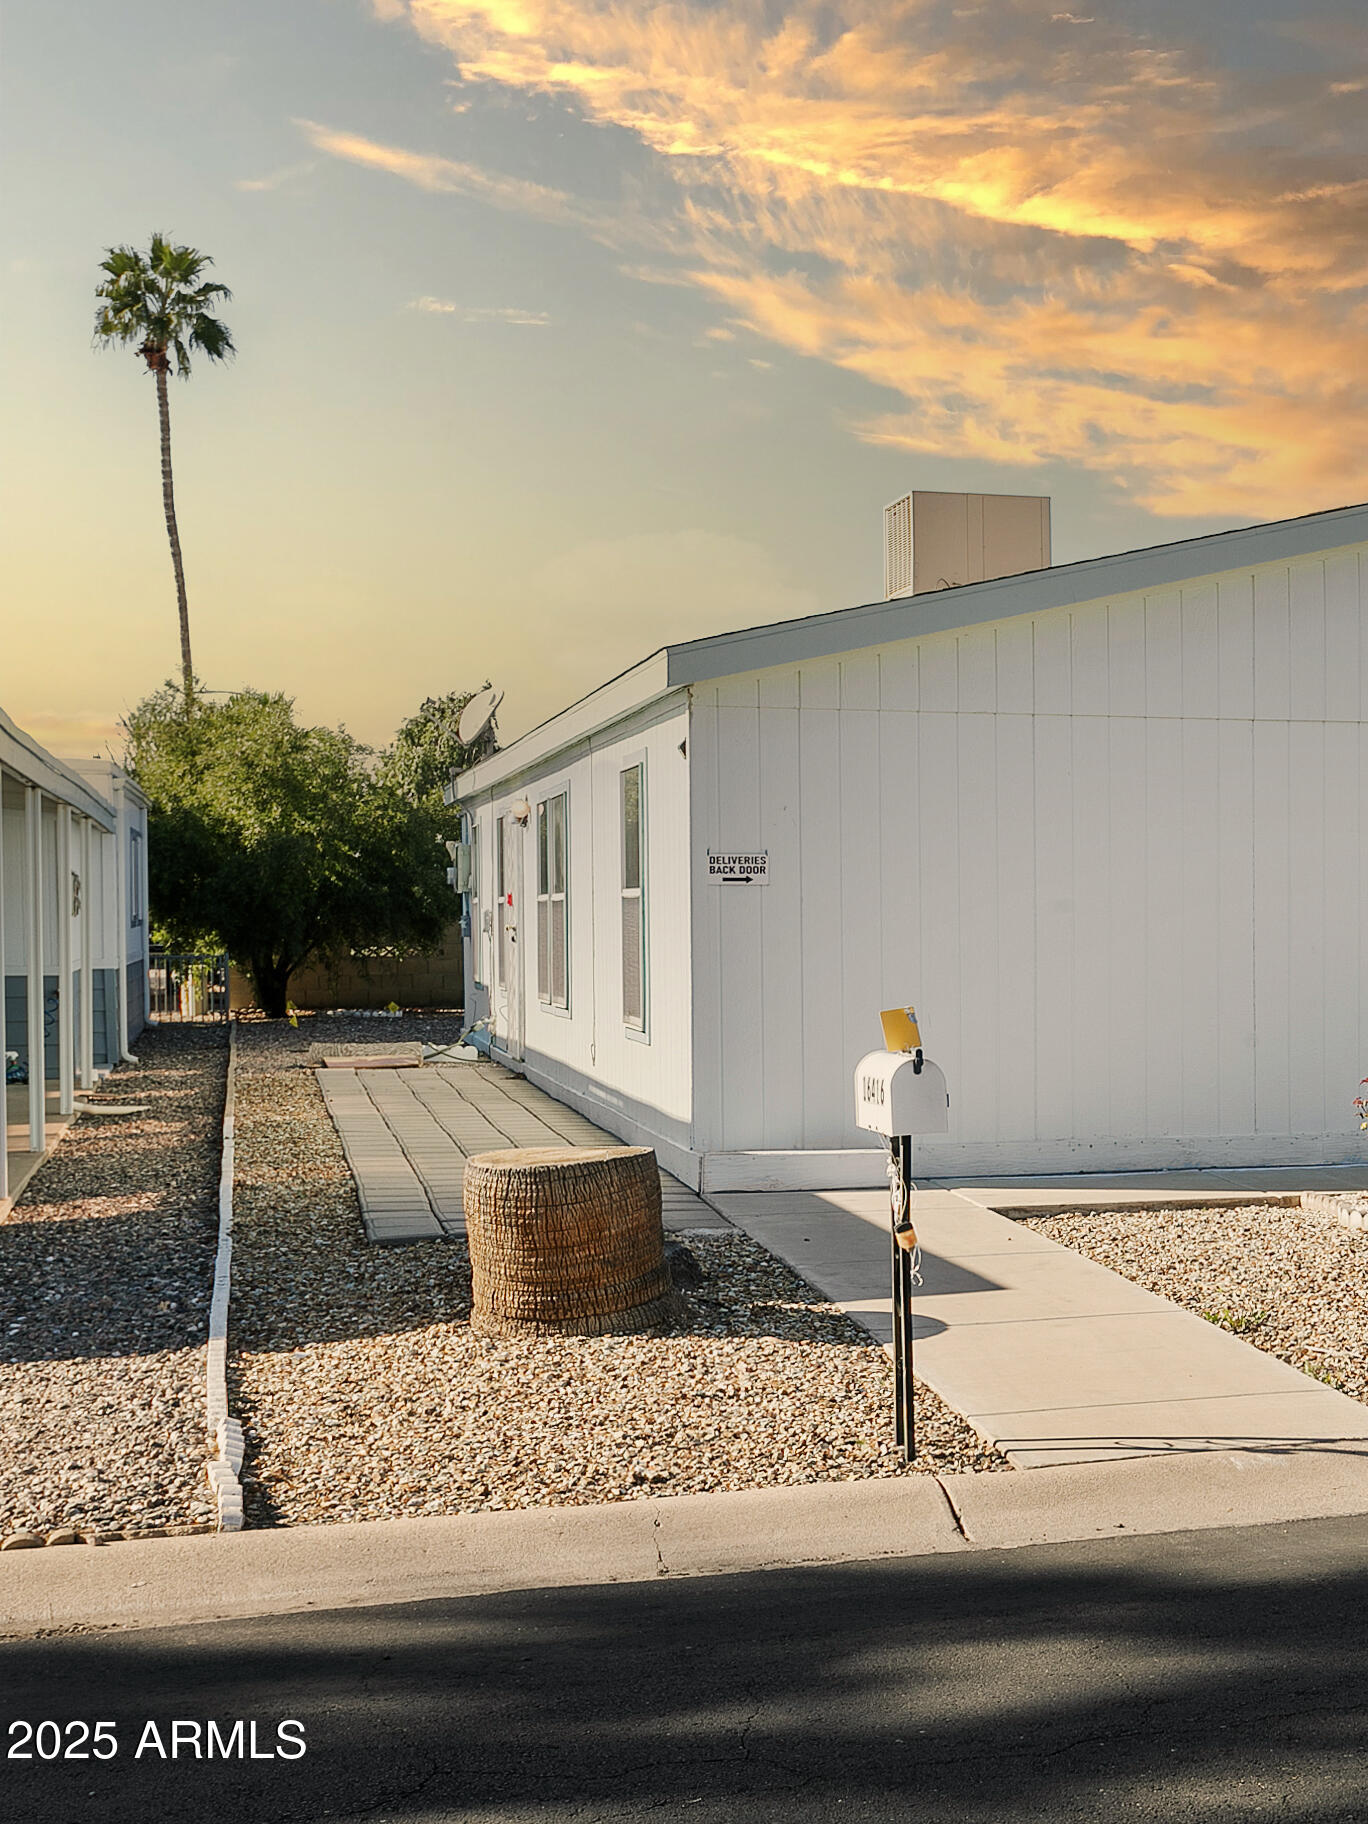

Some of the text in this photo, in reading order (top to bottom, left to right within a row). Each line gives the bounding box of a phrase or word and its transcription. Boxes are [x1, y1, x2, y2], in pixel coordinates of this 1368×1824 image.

[709, 856, 767, 865] DELIVERIES
[709, 866, 766, 875] BACK DOOR
[863, 1076, 885, 1105] 16416
